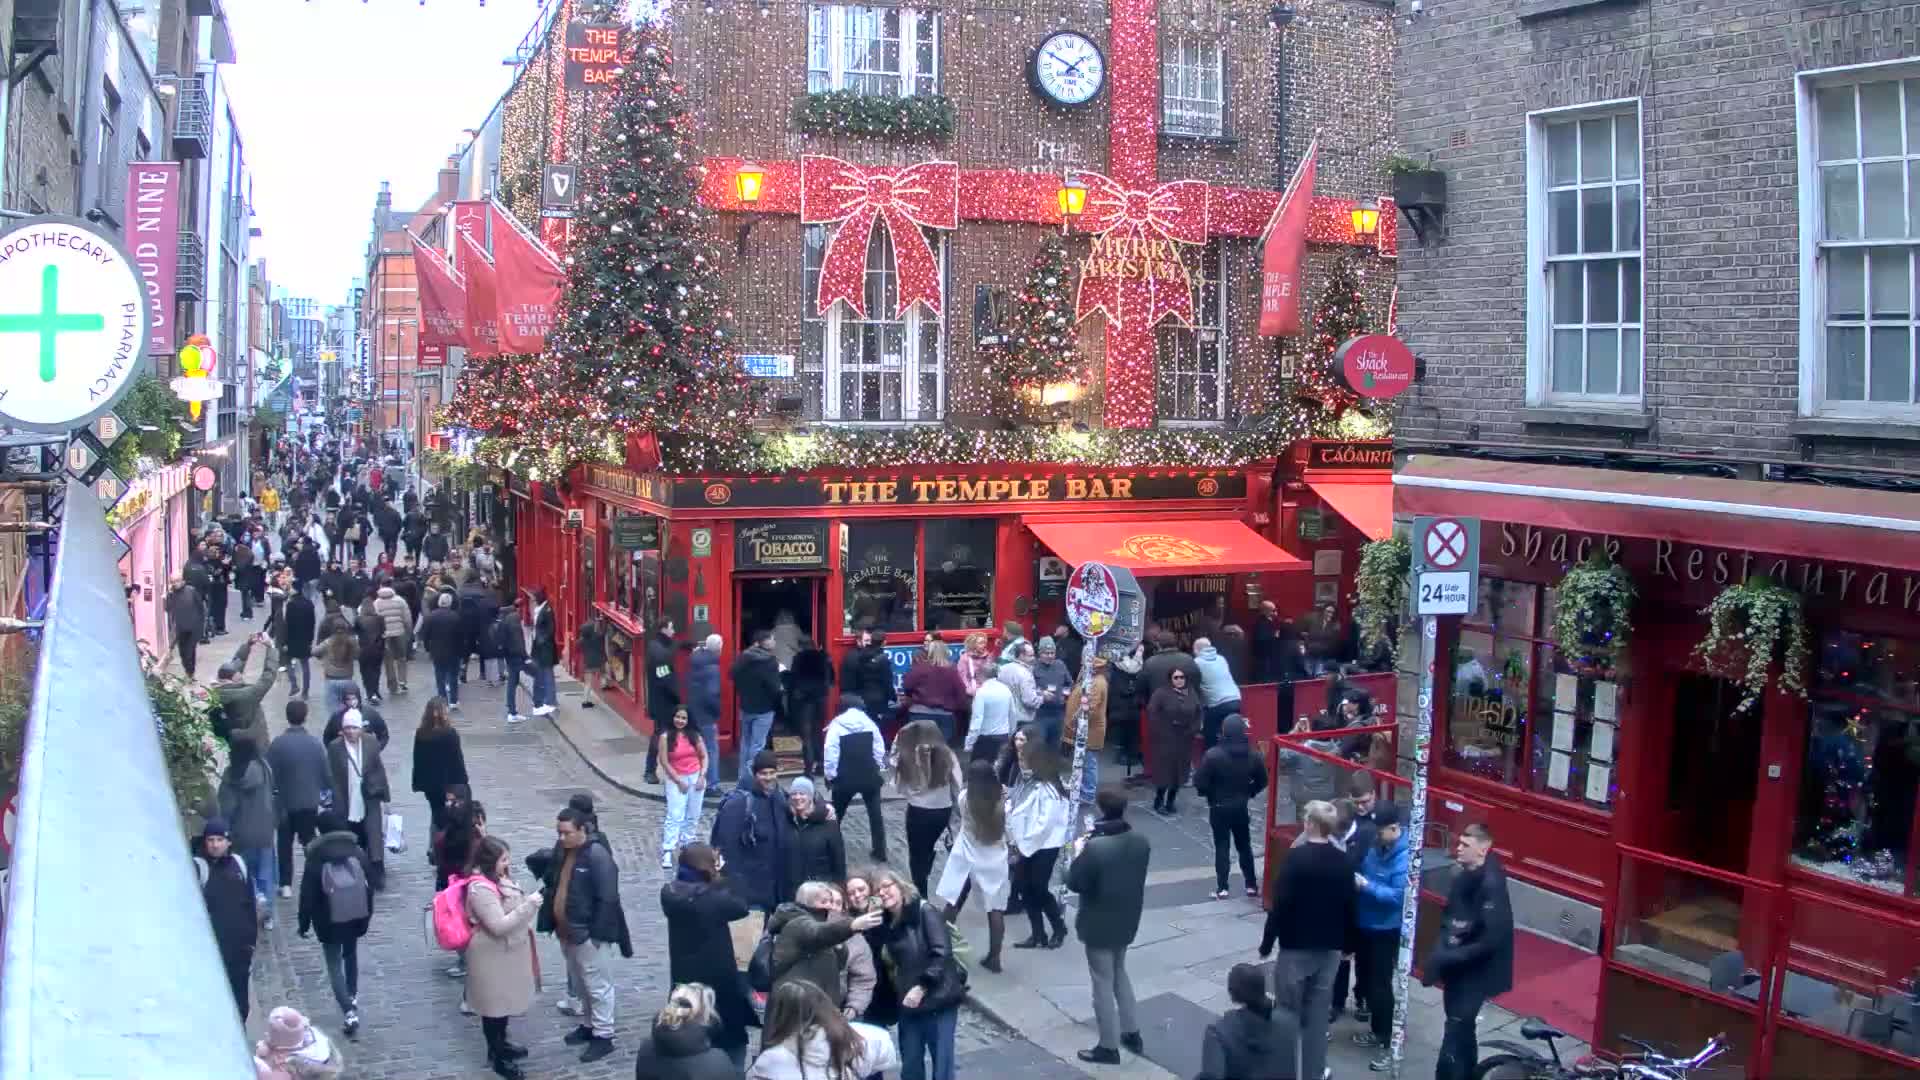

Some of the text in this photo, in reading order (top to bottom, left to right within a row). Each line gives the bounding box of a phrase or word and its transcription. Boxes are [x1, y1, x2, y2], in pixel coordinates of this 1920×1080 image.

[585, 29, 618, 45] THE
[568, 47, 632, 64] TEMPLE
[137, 171, 168, 232] NINE
[0, 232, 113, 266] APOTHECARY
[88, 302, 136, 401] PHARMACY
[520, 304, 546, 312] THE
[503, 313, 557, 326] TEMPL
[519, 326, 550, 337] BAR
[635, 477, 652, 498] BAR
[823, 478, 1133, 503] THE TEMPLE BAR
[749, 538, 817, 562] TOBACCO
[848, 565, 892, 589] TEMPLE
[1422, 583, 1443, 602] 24
[1444, 593, 1466, 602] HOUR
